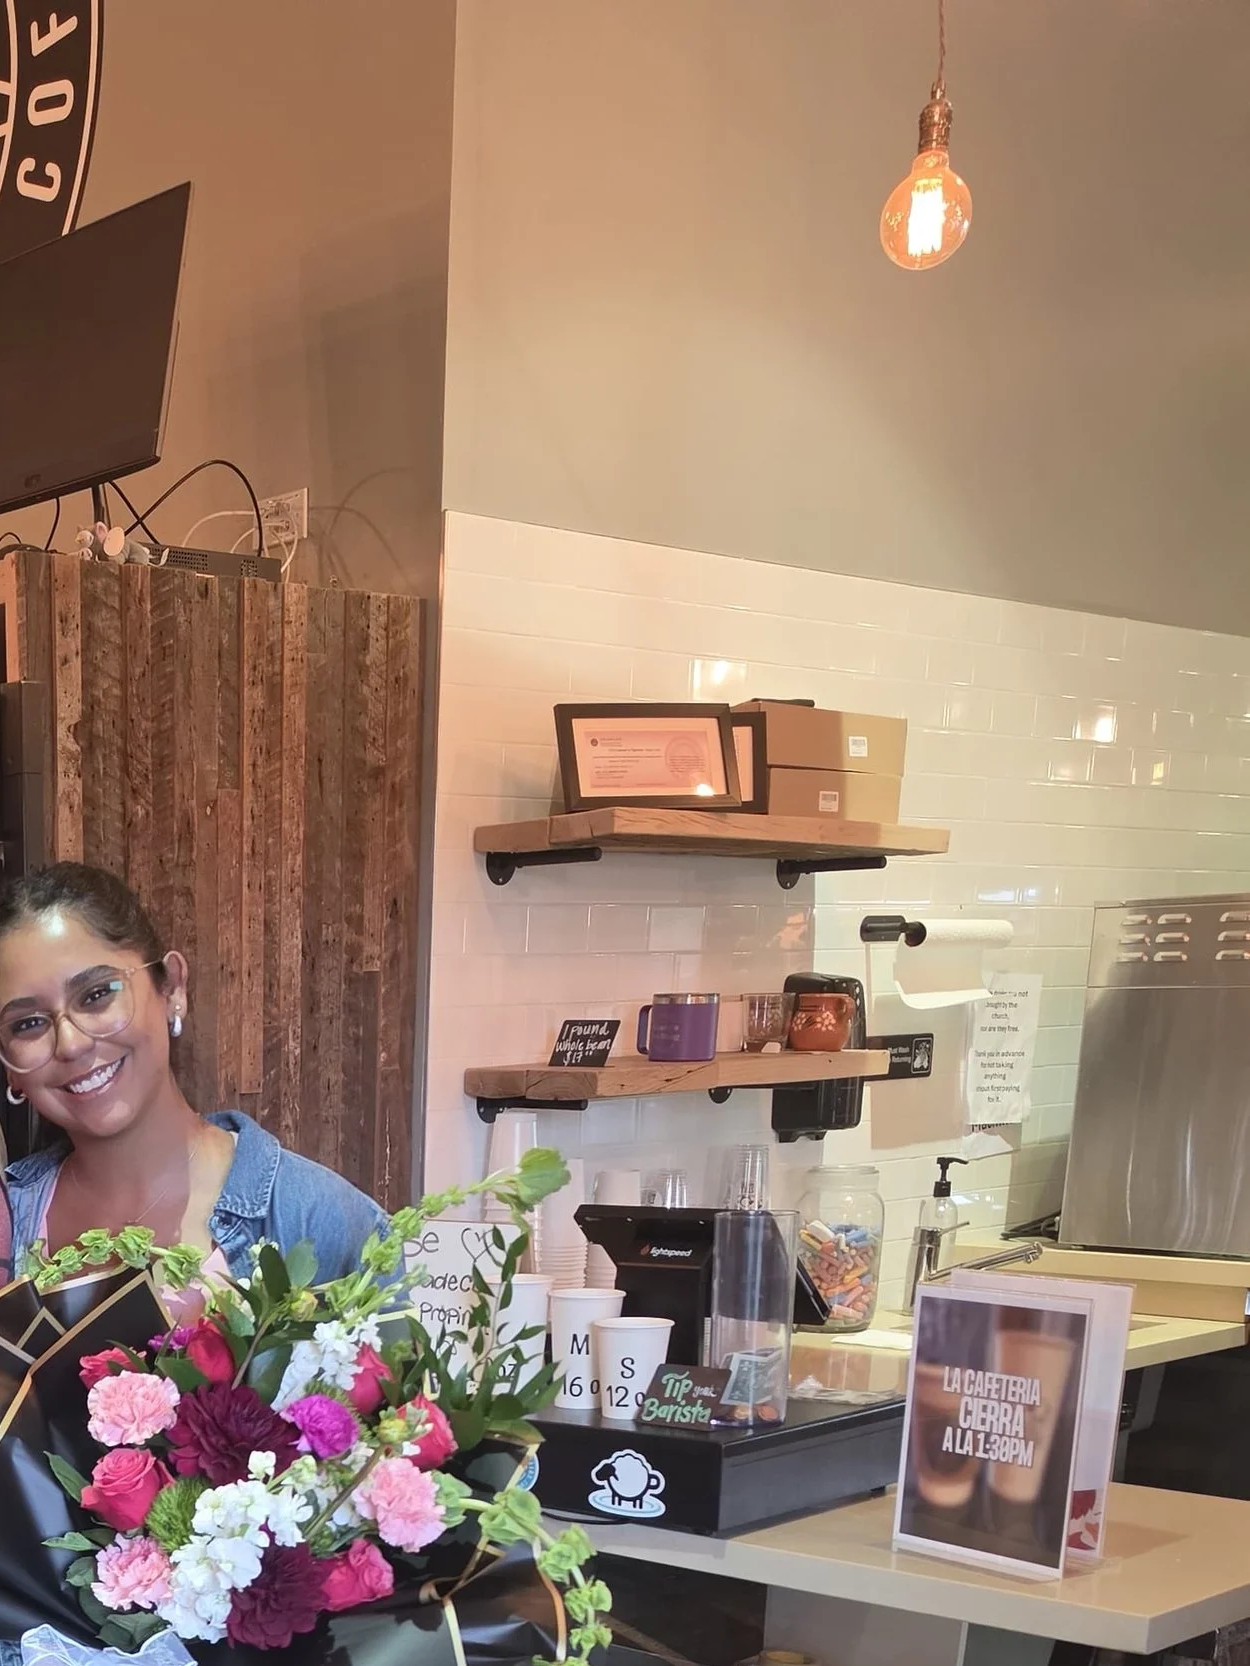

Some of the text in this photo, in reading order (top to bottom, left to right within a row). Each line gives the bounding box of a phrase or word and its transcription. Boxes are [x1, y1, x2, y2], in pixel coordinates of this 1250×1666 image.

[555, 1039, 612, 1052] whole bean
[650, 1246, 693, 1257] lightspeed
[570, 1333, 590, 1355] M
[620, 1357, 635, 1379] S
[606, 1385, 630, 1408] 12
[943, 1366, 1041, 1406] LA CAFETERIA
[641, 1397, 712, 1424] Barista
[959, 1396, 1025, 1438] CIERRA
[942, 1426, 953, 1453] A
[954, 1428, 974, 1456] LA
